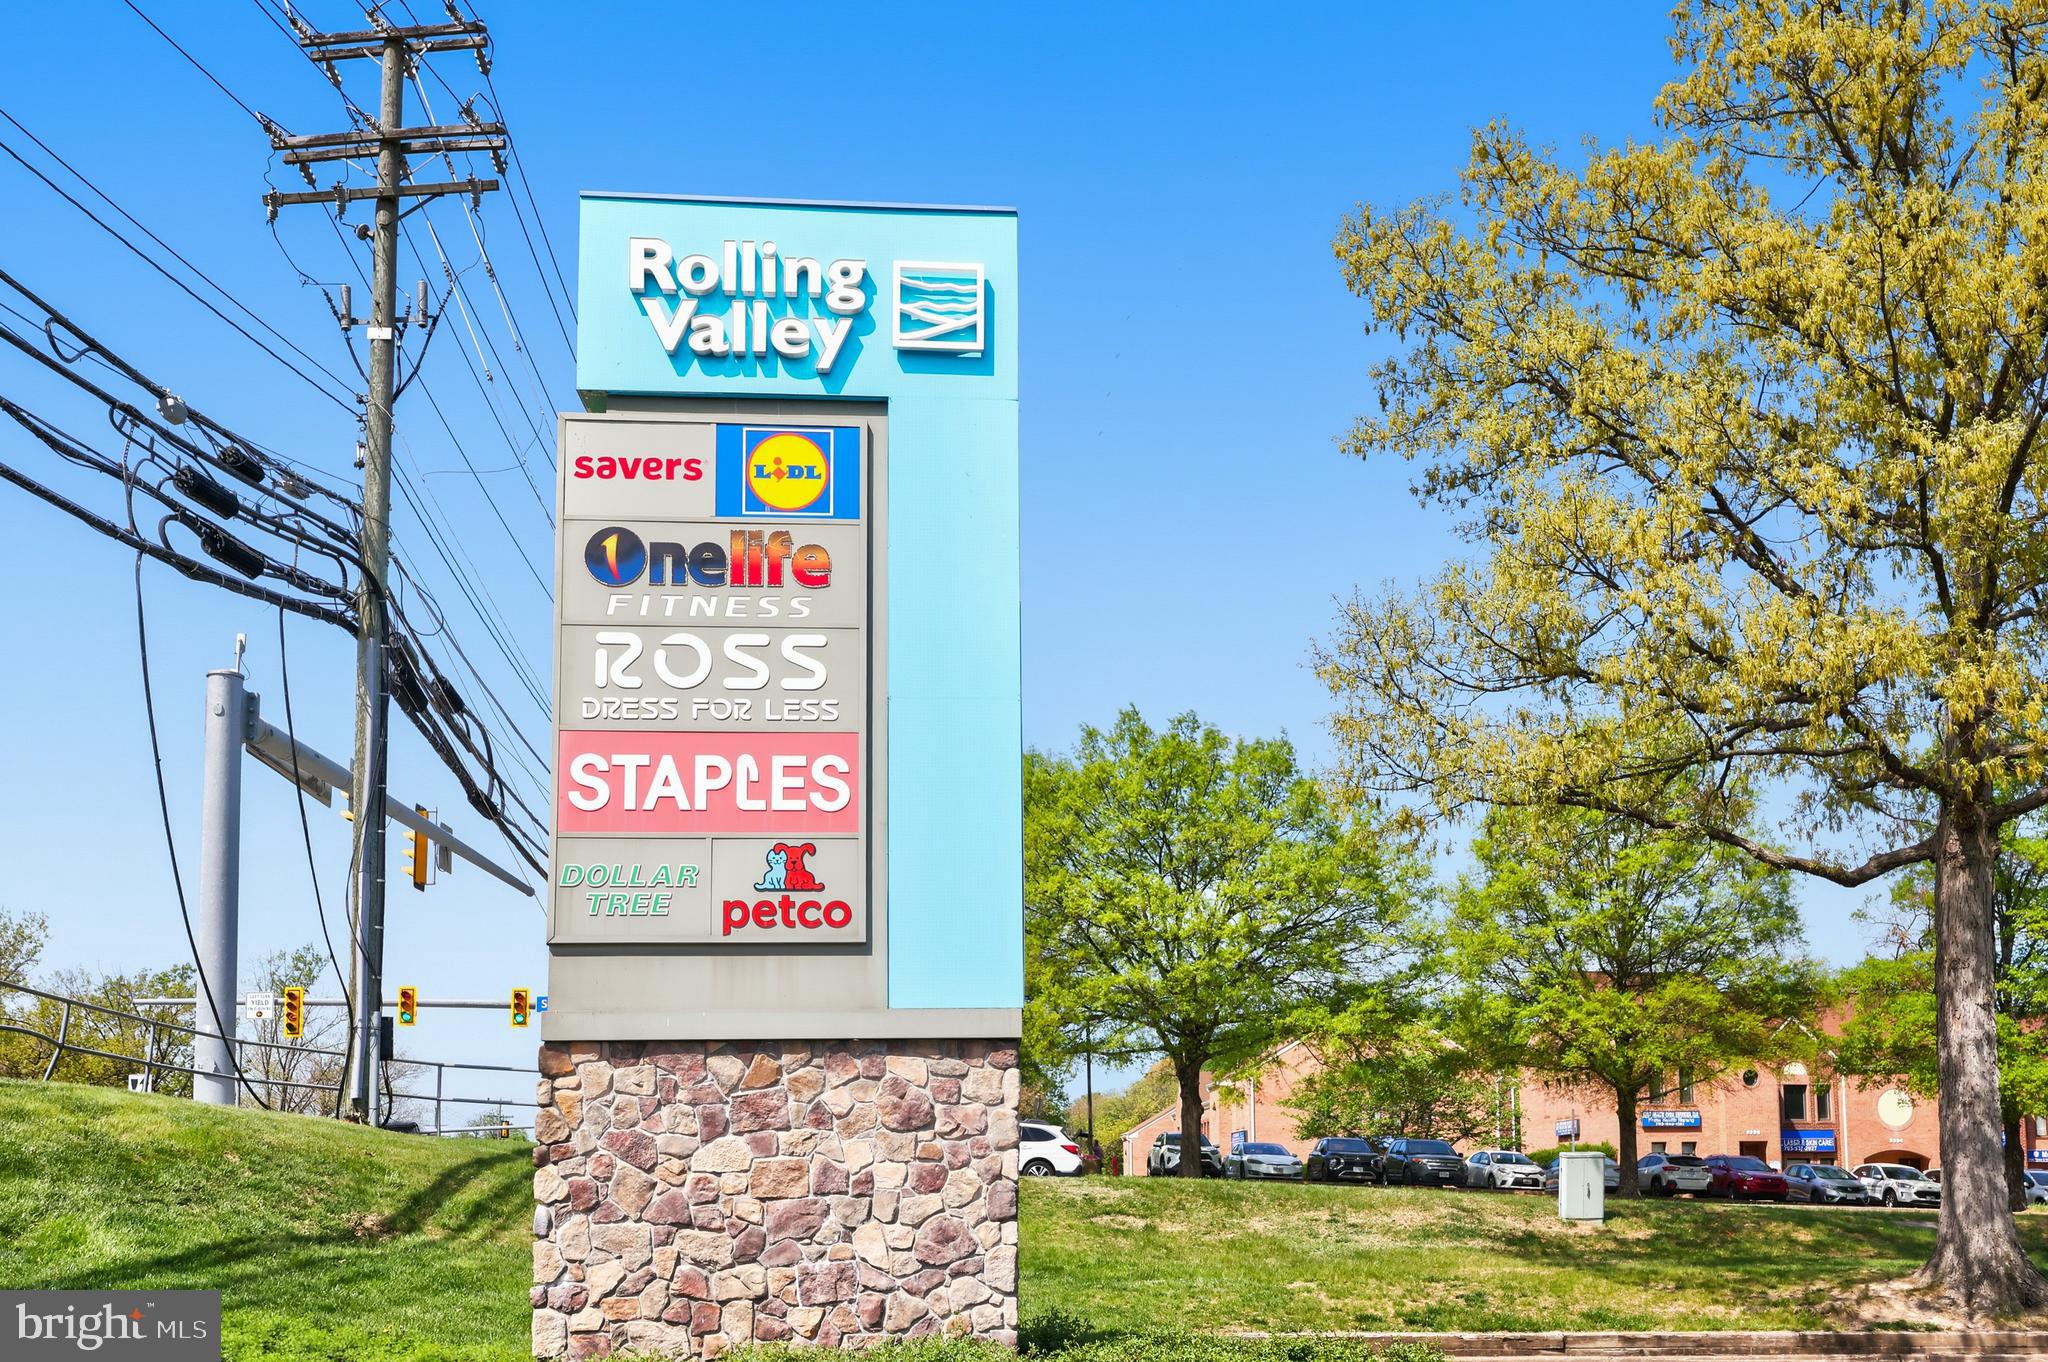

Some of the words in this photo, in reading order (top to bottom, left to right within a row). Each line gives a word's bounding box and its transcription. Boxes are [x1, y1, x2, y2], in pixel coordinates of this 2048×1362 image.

[629, 236, 867, 315] Rolling
[640, 297, 854, 374] Valley
[574, 455, 703, 481] savers
[606, 593, 812, 618] FITNESS
[595, 631, 828, 690] ROSS
[582, 697, 678, 720] DRESS
[691, 698, 752, 721] FOR
[765, 699, 839, 721] LESS
[568, 753, 851, 812] STAPLES
[559, 864, 699, 888] DOLLAR
[586, 892, 673, 917] TREE
[723, 894, 852, 936] petco
